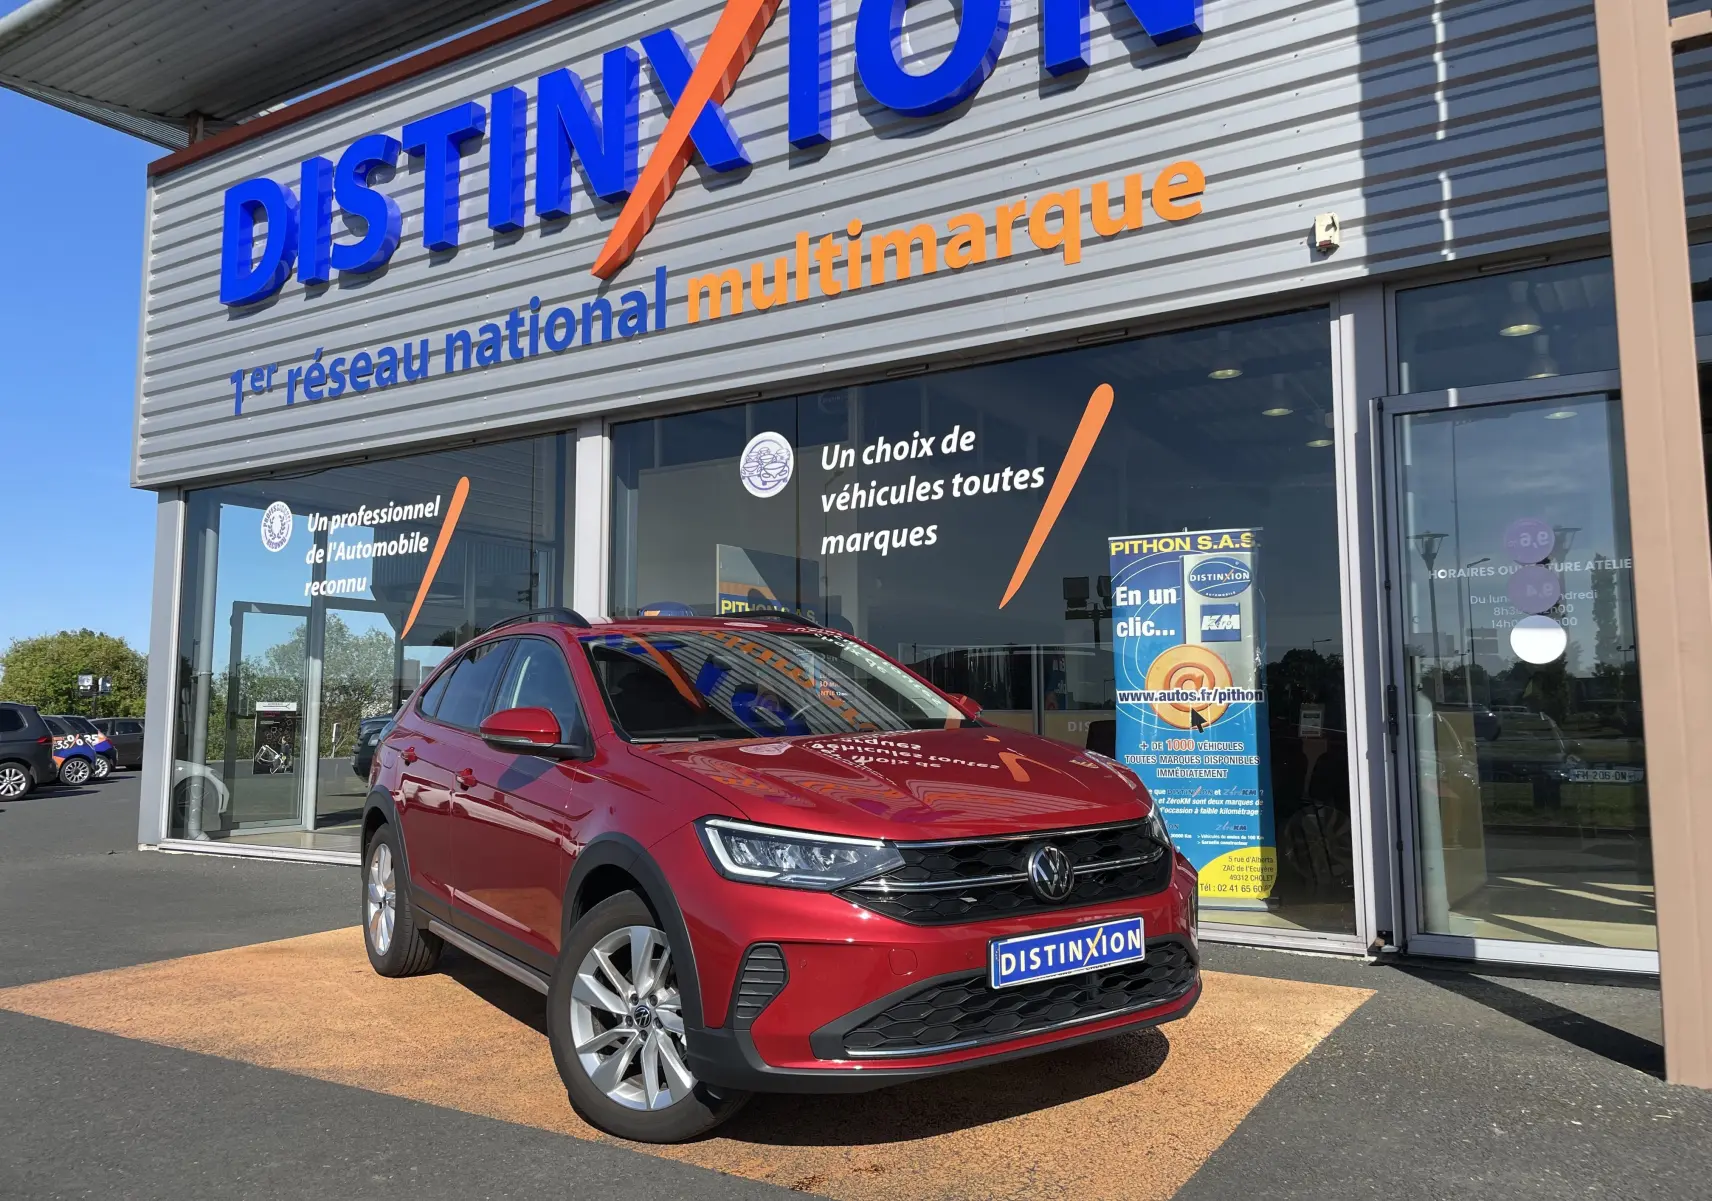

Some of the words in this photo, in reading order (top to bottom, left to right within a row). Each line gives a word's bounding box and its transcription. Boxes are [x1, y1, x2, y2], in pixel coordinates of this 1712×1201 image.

[219, 0, 1203, 307] DISTINXIO
[230, 362, 278, 416] 1er
[286, 346, 430, 405] réseau
[444, 265, 667, 374] national
[686, 159, 1206, 326] multimarque
[821, 444, 855, 471] Un
[862, 431, 934, 466] choix
[941, 425, 976, 454] de
[820, 475, 945, 513] véhicules
[951, 466, 1045, 497] toutes
[307, 512, 328, 533] Un
[329, 494, 441, 534] professionnel
[305, 548, 323, 565] de
[326, 531, 429, 563] l'Automobile
[820, 524, 938, 557] marques
[1110, 537, 1191, 556] PITHON
[1197, 532, 1261, 550] S.A.S.
[1189, 569, 1250, 582] DISTINXION
[1428, 566, 1495, 579] HORAIRES
[1498, 560, 1580, 576] OUTURE
[1584, 558, 1632, 571] ATELIE
[304, 576, 367, 597] reconnu
[1115, 586, 1142, 607] En
[1148, 587, 1177, 605] un
[1470, 595, 1486, 605] Du
[1489, 594, 1508, 604] lun
[1559, 589, 1598, 601] ndredi
[1116, 616, 1176, 638] clic...
[1117, 688, 1264, 704] www.autos.fr/pithon
[1151, 742, 1163, 751] DE
[1166, 739, 1196, 751] 1000
[1197, 740, 1244, 751] VÉHICULES
[1125, 754, 1157, 765] TOUTES
[1159, 754, 1201, 765] MARQUES
[1203, 755, 1261, 766] DISPONIBLES
[1156, 766, 1228, 779] IMMÉDIATEMENT
[1154, 789, 1166, 797] que
[1225, 799, 1254, 807] marques
[1220, 807, 1260, 816] kilométrage
[1200, 883, 1211, 892] Tél
[1217, 884, 1226, 892] 02
[1229, 884, 1238, 892] 41
[1241, 884, 1250, 892] 65
[1253, 885, 1262, 893] 60
[1250, 874, 1274, 882] CHOLET
[1000, 926, 1141, 976] DISTINXION
